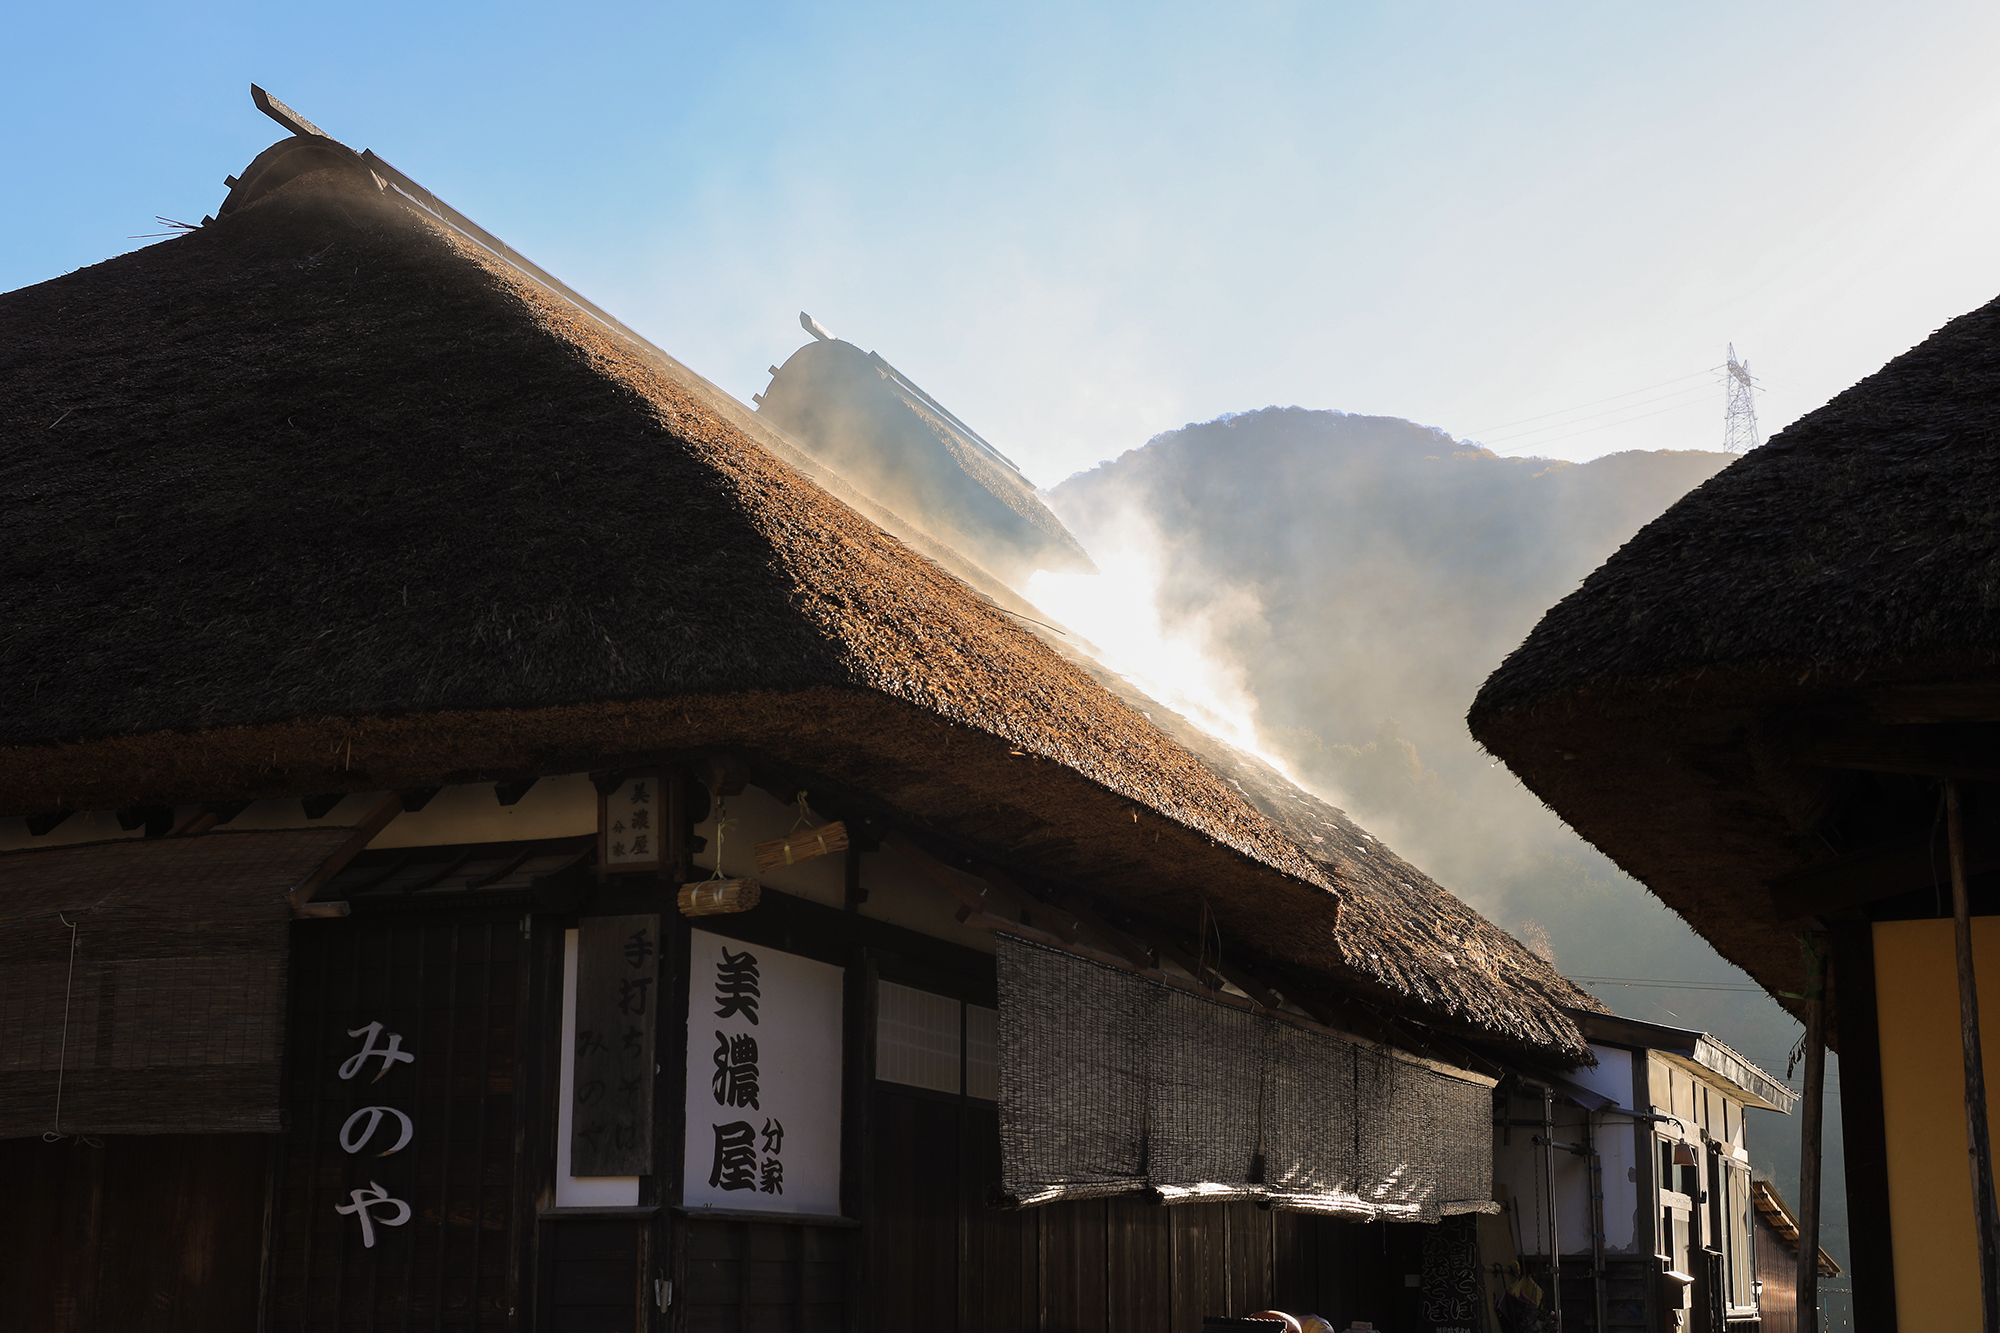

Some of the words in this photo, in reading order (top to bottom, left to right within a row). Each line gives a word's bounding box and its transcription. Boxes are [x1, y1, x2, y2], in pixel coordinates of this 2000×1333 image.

[612, 820, 626, 857] 分家
[630, 782, 650, 855] 美濃屋
[578, 1031, 609, 1150] みのや
[709, 946, 760, 1192] 美濃屋
[335, 1021, 414, 1248] みのや
[760, 1117, 784, 1195] 分家
